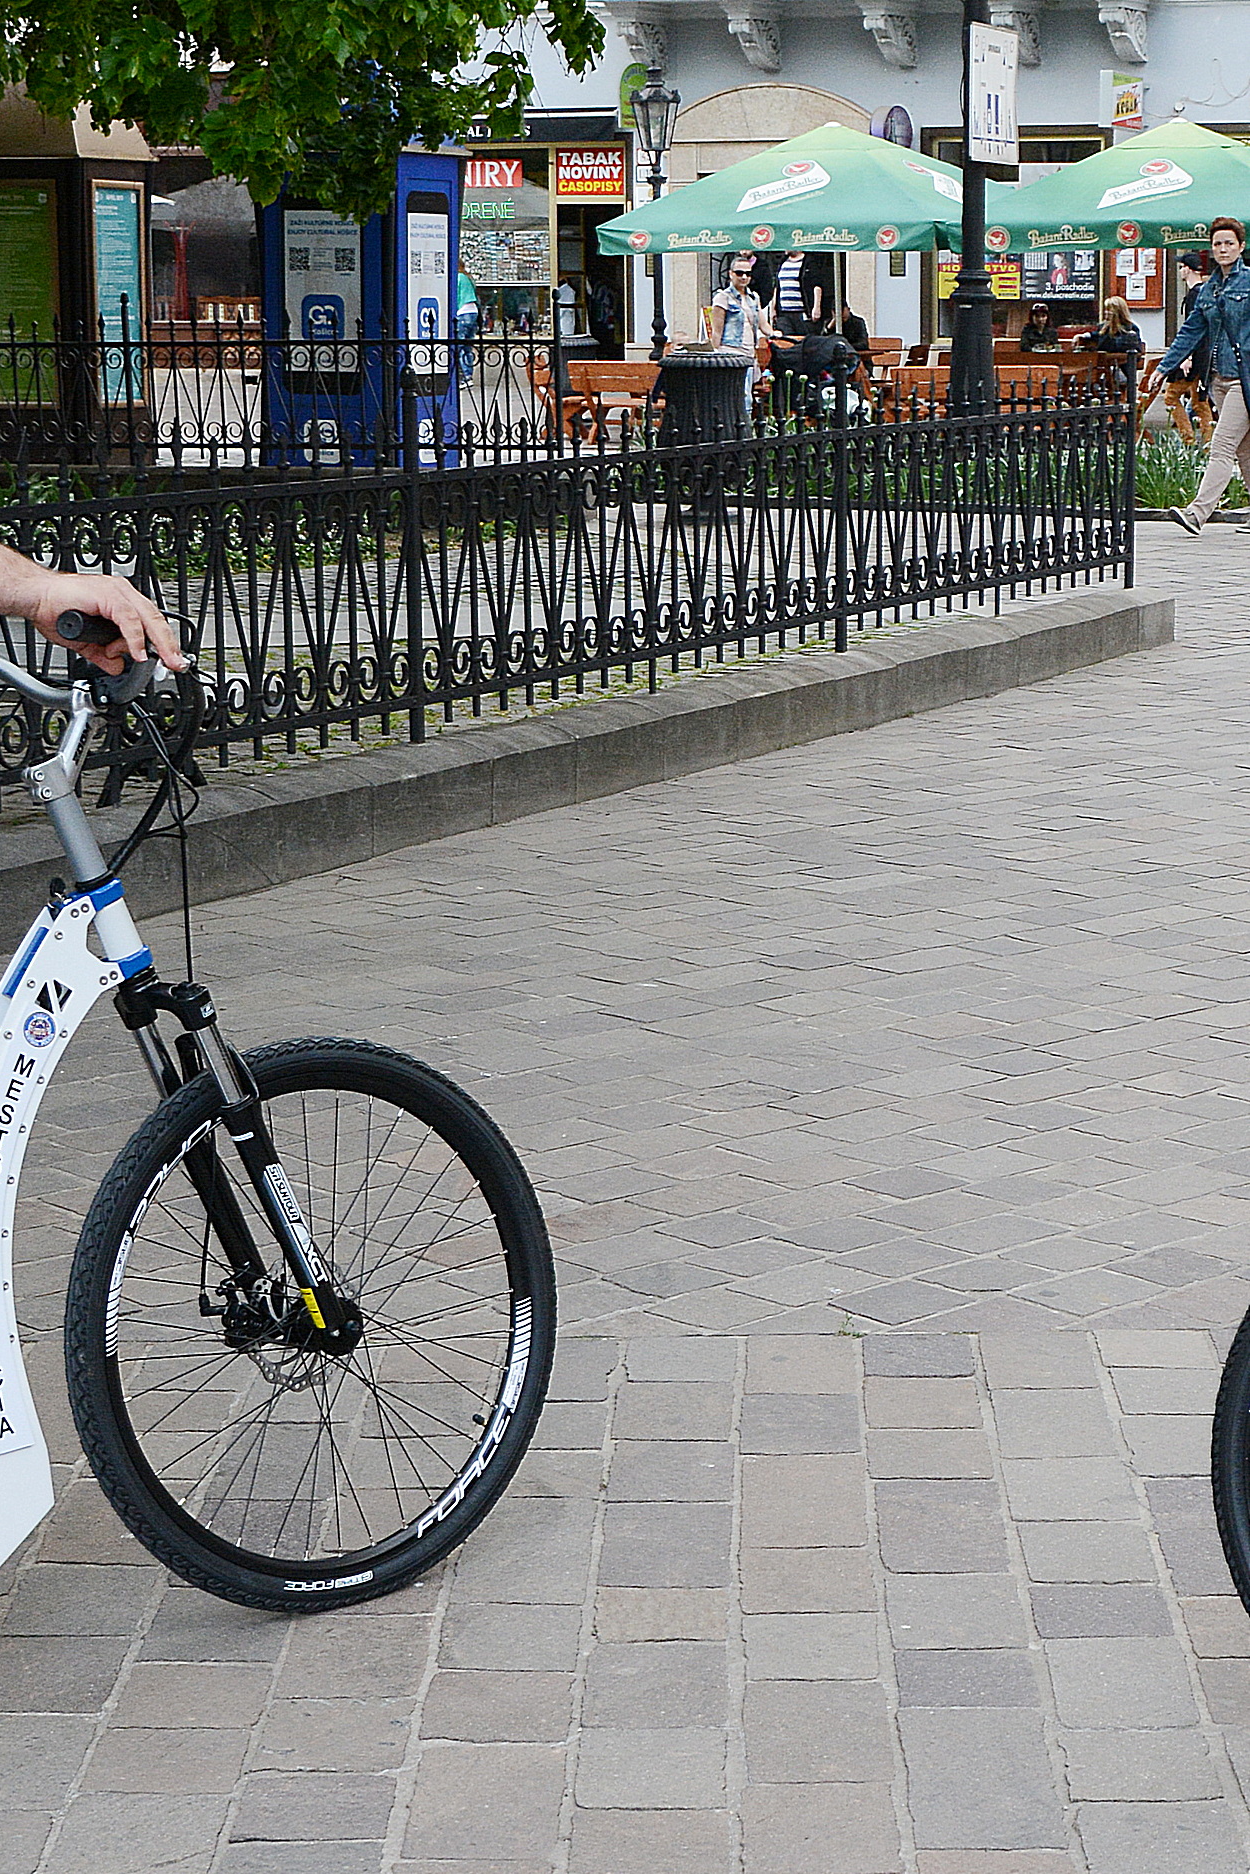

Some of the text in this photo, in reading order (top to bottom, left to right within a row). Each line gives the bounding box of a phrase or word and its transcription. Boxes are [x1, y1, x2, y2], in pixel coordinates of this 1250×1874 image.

[559, 152, 622, 165] TABAK
[559, 166, 623, 179] NOVINY
[559, 180, 623, 192] ČASOPISY
[784, 177, 819, 191] Radler
[1144, 176, 1180, 191] Radler
[305, 1242, 329, 1283] XCT
[417, 1404, 511, 1539] FORCE
[283, 1580, 334, 1591] FORCE
